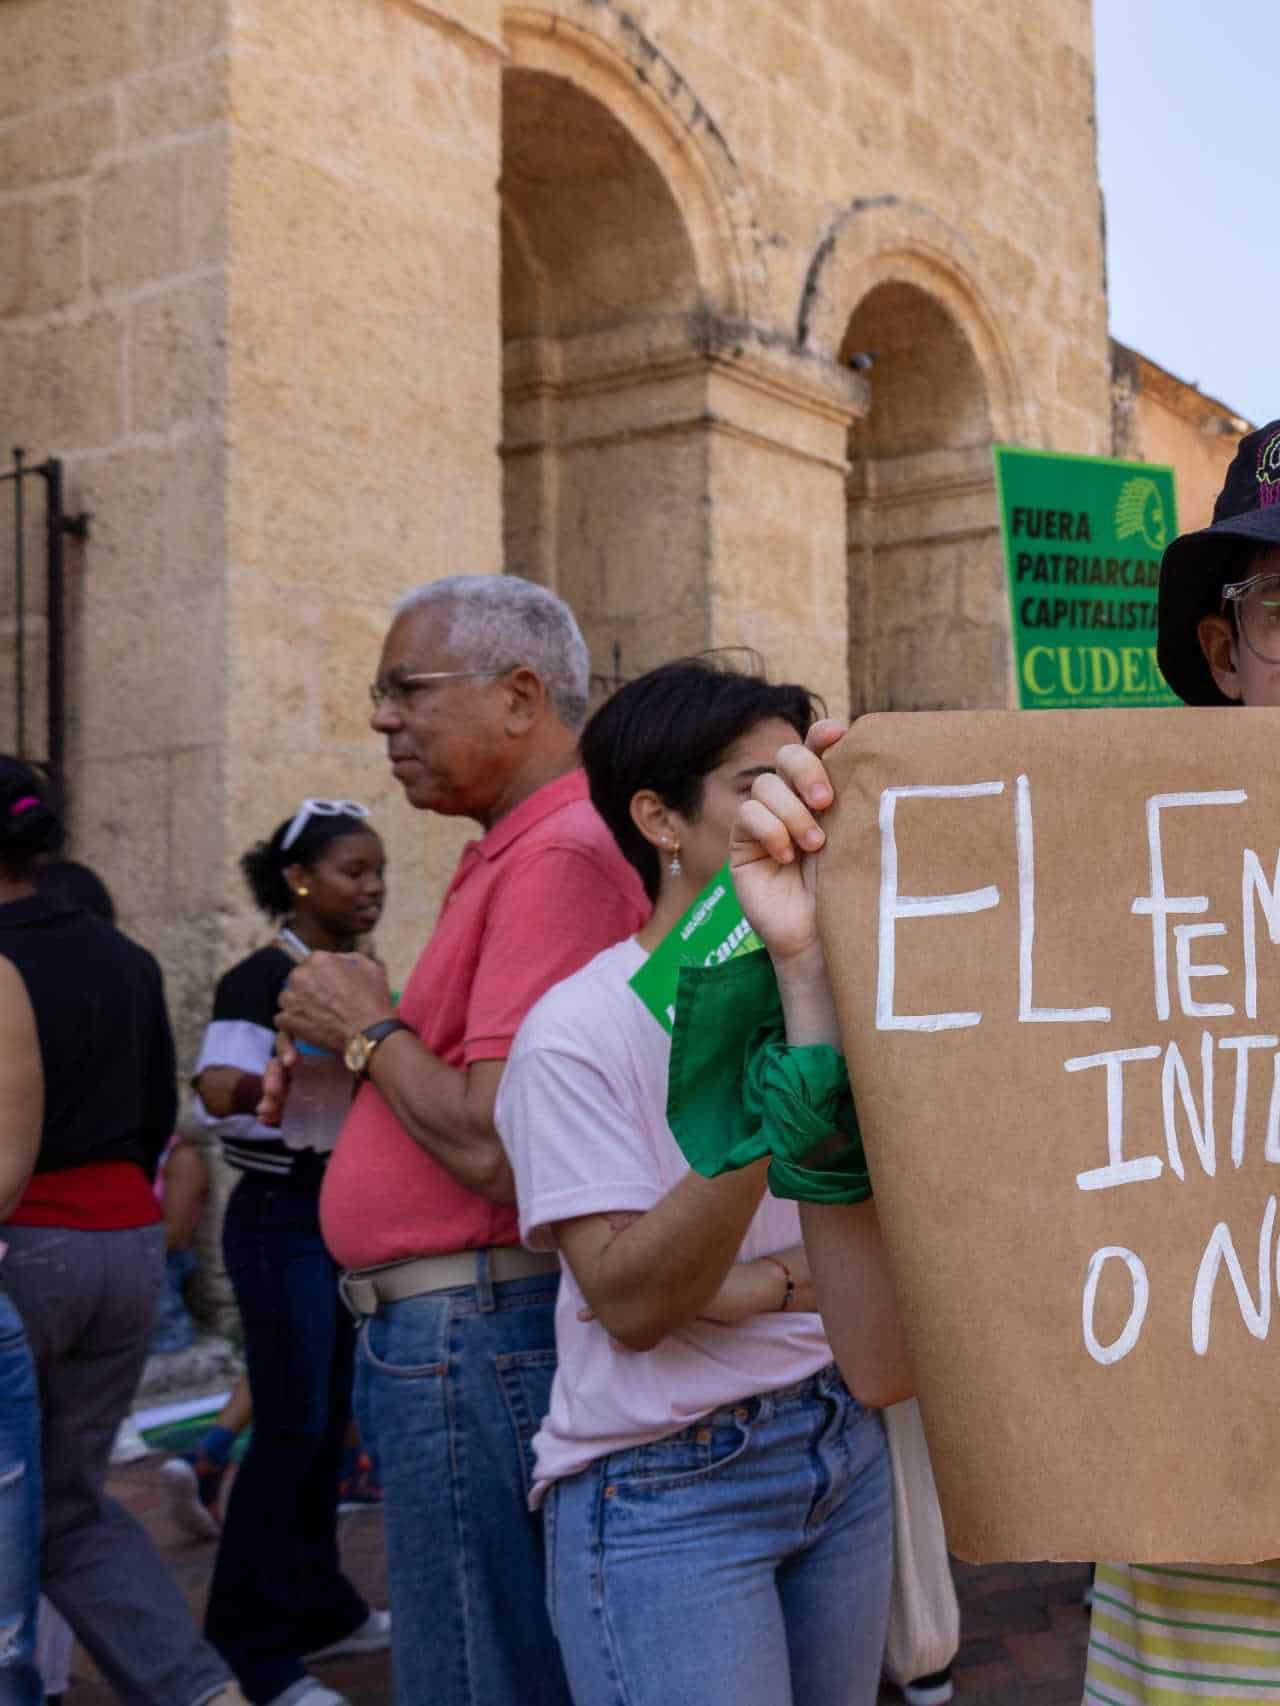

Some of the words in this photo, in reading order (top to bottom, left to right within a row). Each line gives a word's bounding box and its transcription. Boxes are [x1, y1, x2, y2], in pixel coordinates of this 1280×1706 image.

[1012, 506, 1090, 542] FUERA
[876, 774, 1111, 1032] EL
[1082, 1246, 1149, 1365] O
